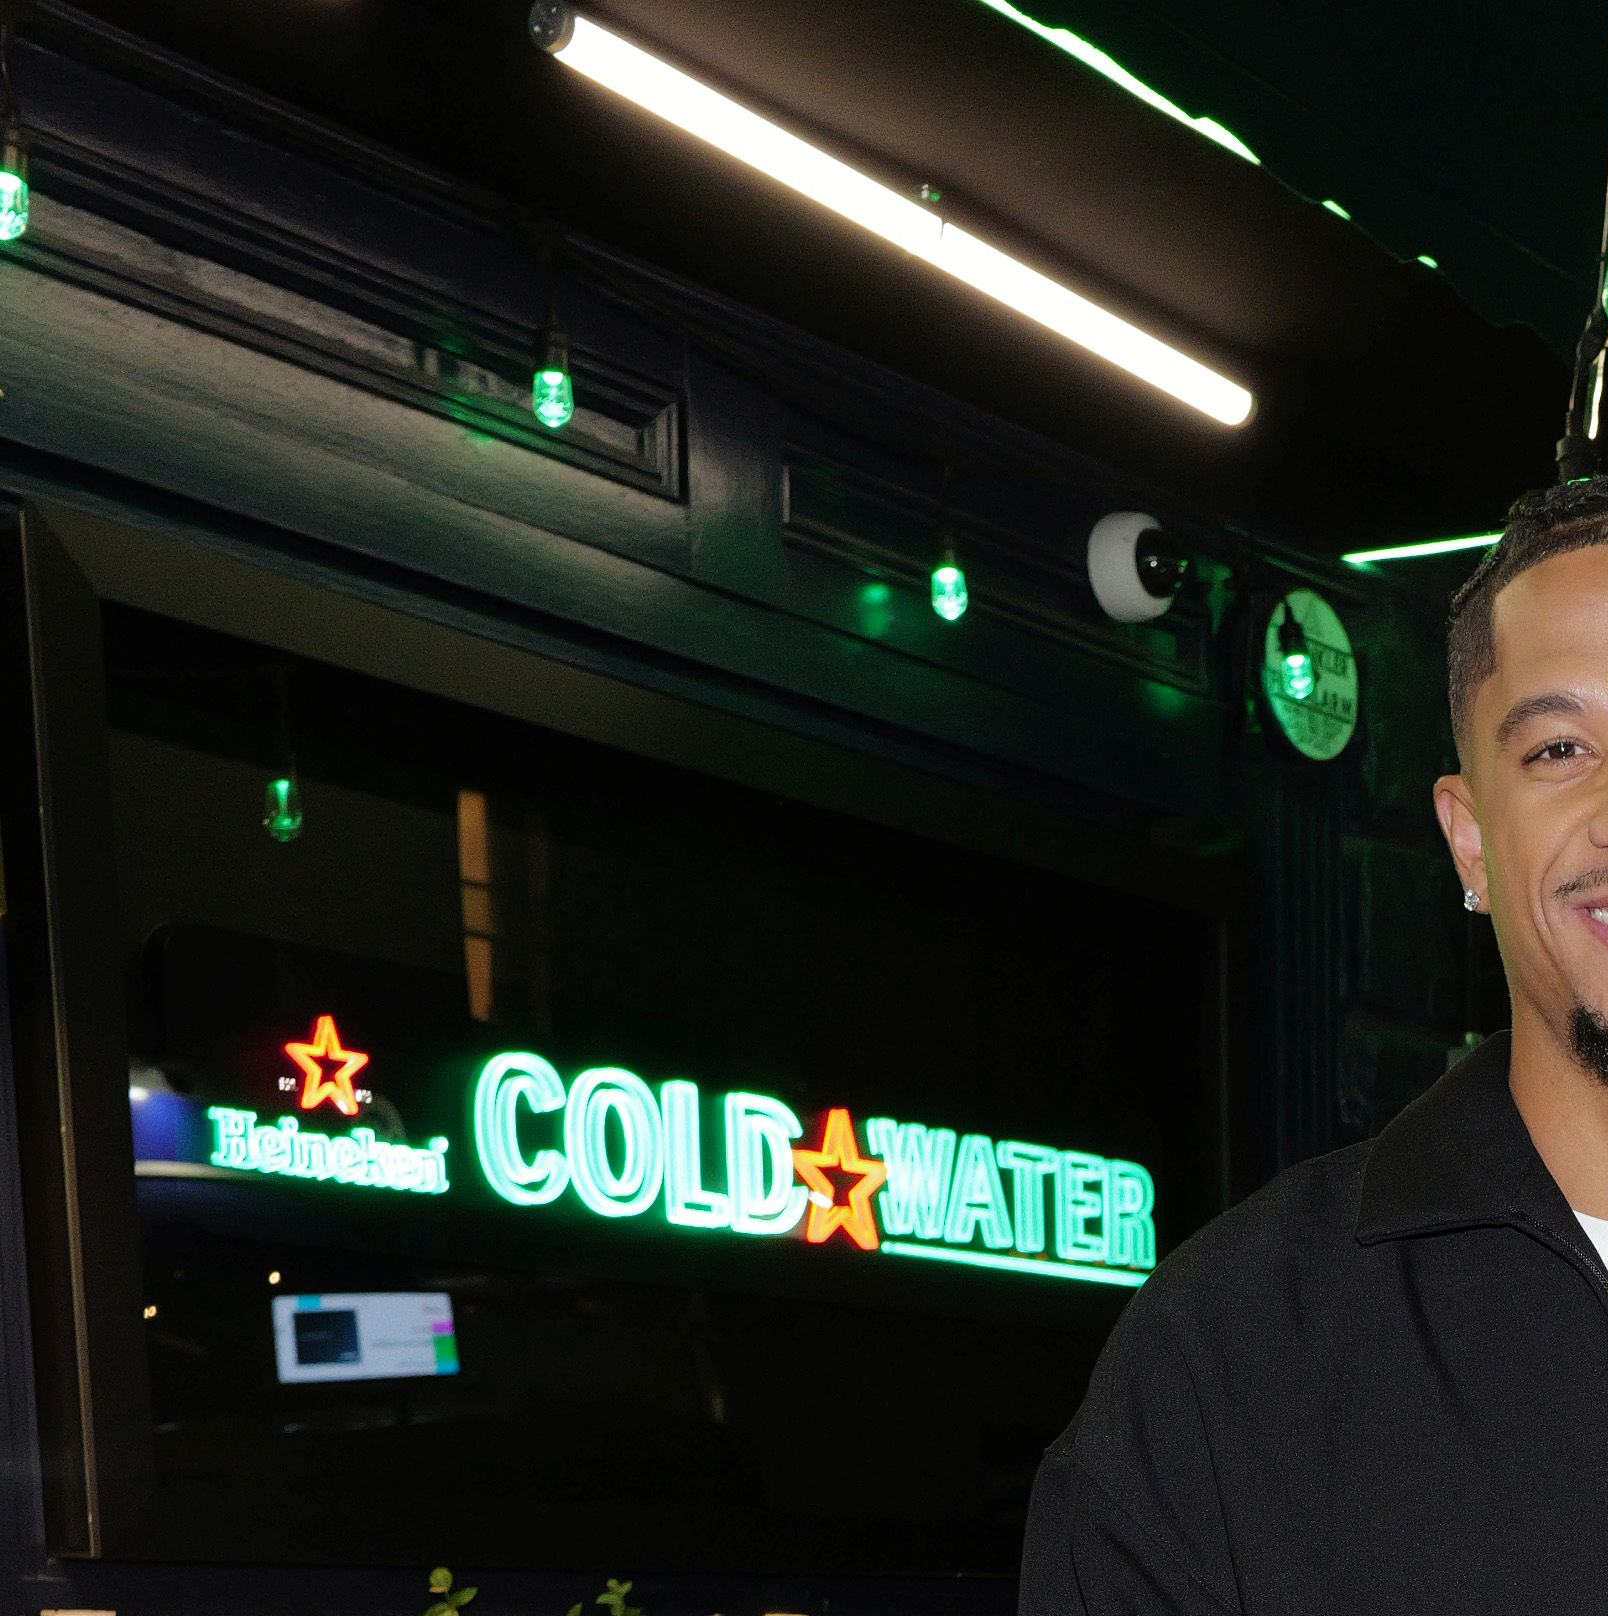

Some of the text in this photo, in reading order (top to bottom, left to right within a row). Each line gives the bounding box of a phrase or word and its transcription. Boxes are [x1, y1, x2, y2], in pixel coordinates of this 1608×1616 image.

[207, 1105, 450, 1195] Heineken
[474, 1051, 1157, 1269] COLD WATER
